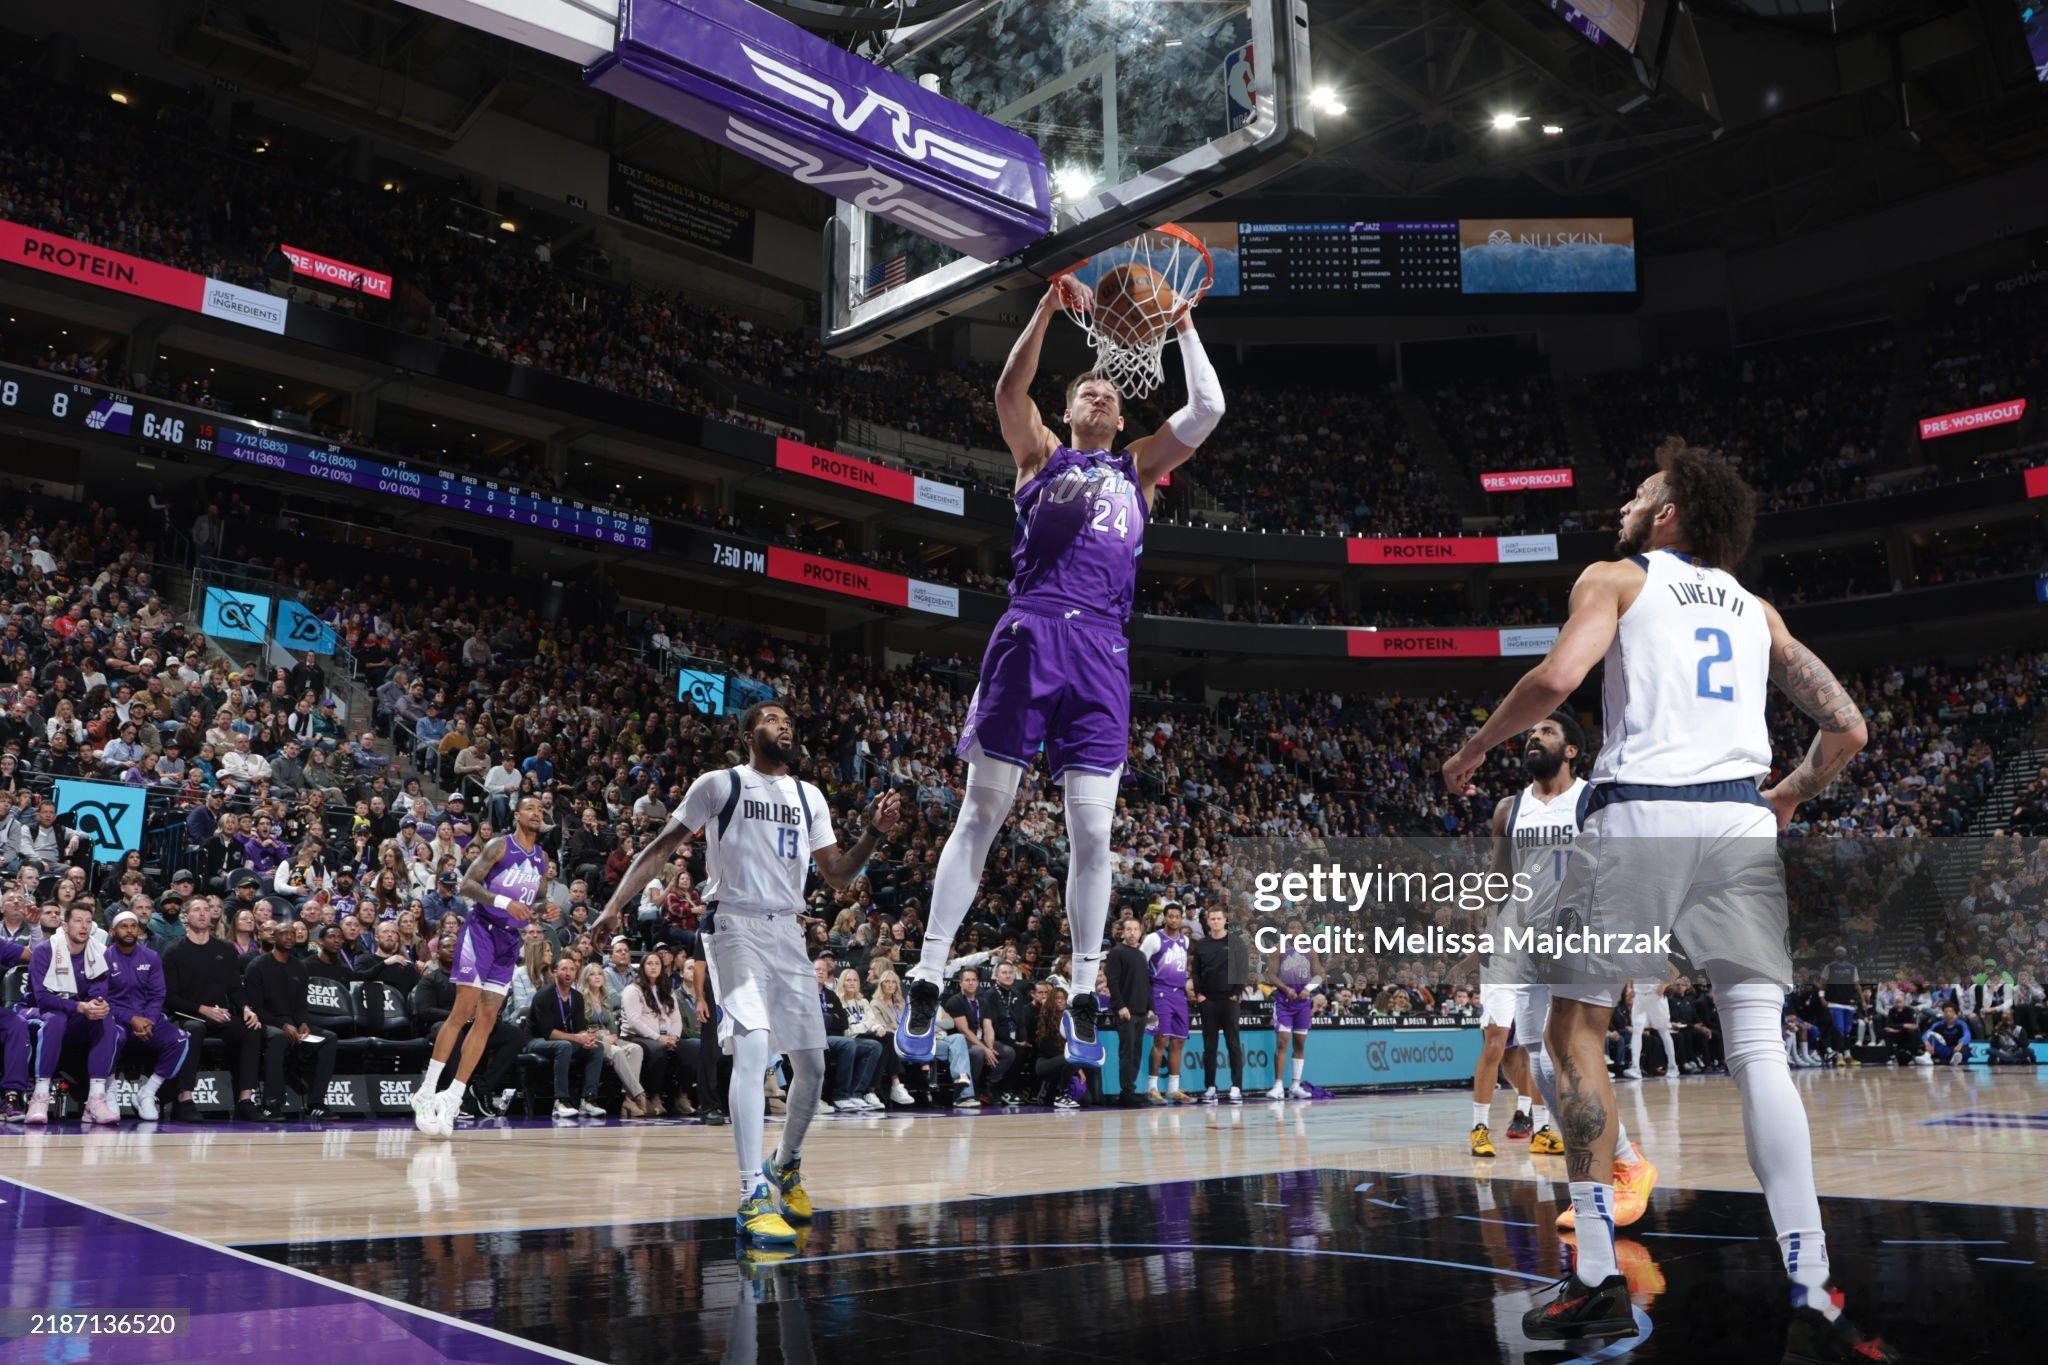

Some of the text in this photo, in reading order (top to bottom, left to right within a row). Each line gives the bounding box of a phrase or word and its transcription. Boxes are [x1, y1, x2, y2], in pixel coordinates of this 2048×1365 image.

[1586, 20, 1600, 43] UTA
[617, 162, 643, 179] TEXT
[666, 180, 696, 201] DELTA
[698, 192, 711, 205] TO
[1253, 224, 1287, 232] MAVERICKS
[1363, 223, 1380, 231] JAZZ
[1556, 232, 1603, 246] SKIN
[23, 237, 139, 286] PROTEIN.
[213, 289, 235, 301] JUST
[213, 297, 278, 322] INGREDIENTS
[80, 386, 92, 395] TOL
[52, 393, 69, 417] 8
[115, 394, 128, 403] FLS
[1924, 404, 2023, 435] PRE-WORKOUT.
[143, 413, 184, 443] 6:46
[258, 428, 268, 437] FG
[195, 438, 213, 451] 1ST
[328, 444, 341, 453] 3PT
[398, 461, 407, 469] FT
[811, 454, 878, 486] PROTEIN.
[235, 432, 257, 447] 7/12
[259, 439, 288, 454] (58%)
[308, 450, 327, 463] 4/5
[328, 455, 357, 470] (80%)
[382, 466, 398, 479] 0/1
[399, 471, 420, 485] (0%)
[442, 481, 449, 491] 3
[465, 486, 472, 496] 5
[487, 491, 495, 500] 8
[510, 496, 516, 506] 5
[596, 515, 603, 525] 0
[613, 519, 627, 531] 172
[634, 525, 646, 535] 80
[1483, 473, 1570, 488] PRE-WORKOUT.
[919, 485, 933, 493] JUST
[233, 447, 255, 461] 4/11
[256, 452, 286, 469] (36%)
[310, 464, 329, 478] 0/2
[330, 467, 352, 483] (0%)
[379, 480, 398, 493] 0/0
[399, 484, 421, 499] (0%)
[441, 494, 448, 504] 2
[464, 499, 471, 509] 2
[486, 504, 493, 514] 4
[508, 509, 516, 519] 2
[530, 513, 538, 524] 0
[552, 518, 559, 528] 0
[595, 528, 602, 538] 0
[613, 532, 626, 543] 80
[633, 536, 647, 548] 172
[486, 481, 498, 490] REB
[508, 486, 520, 495] AST
[530, 491, 541, 500] STL
[551, 496, 563, 505] BLK
[573, 501, 584, 510] TOV
[591, 505, 610, 516] BENCH
[919, 491, 961, 507] INGREDIENTS
[1091, 498, 1129, 539] 24
[1383, 545, 1456, 558] PROTEIN.
[1505, 546, 1552, 555] INGREDIENTS
[713, 544, 765, 574] 7:50 PM
[803, 562, 871, 591] PROTEIN.
[913, 587, 927, 595] JUST
[913, 594, 954, 608] INGREDIENTS
[1668, 581, 1744, 618] LIVELY II
[1384, 638, 1457, 651] PROTEIN.
[1694, 627, 1734, 702] 2
[743, 799, 801, 826] DALLAS
[777, 827, 799, 860] 13
[1516, 824, 1573, 849] DALLAS
[1553, 849, 1575, 882] 1
[502, 868, 541, 888] UTAH
[520, 886, 535, 906] 20
[1177, 960, 1186, 972] 23
[307, 983, 338, 998] SEAT
[307, 994, 340, 1008] GEEK
[1239, 1016, 1262, 1025] DELTA
[1311, 1017, 1333, 1025] DELTA
[1345, 1017, 1365, 1025] DELTA
[1378, 1017, 1397, 1025] DELTA
[1408, 1017, 1427, 1025] DELTA
[1437, 1017, 1456, 1025] DELTA
[1466, 1017, 1481, 1025] DELT
[1391, 1040, 1454, 1064] awardco
[193, 1078, 217, 1090] AT
[327, 1081, 352, 1093] EAT
[380, 1081, 412, 1093] SEAT
[191, 1090, 220, 1104] EEK
